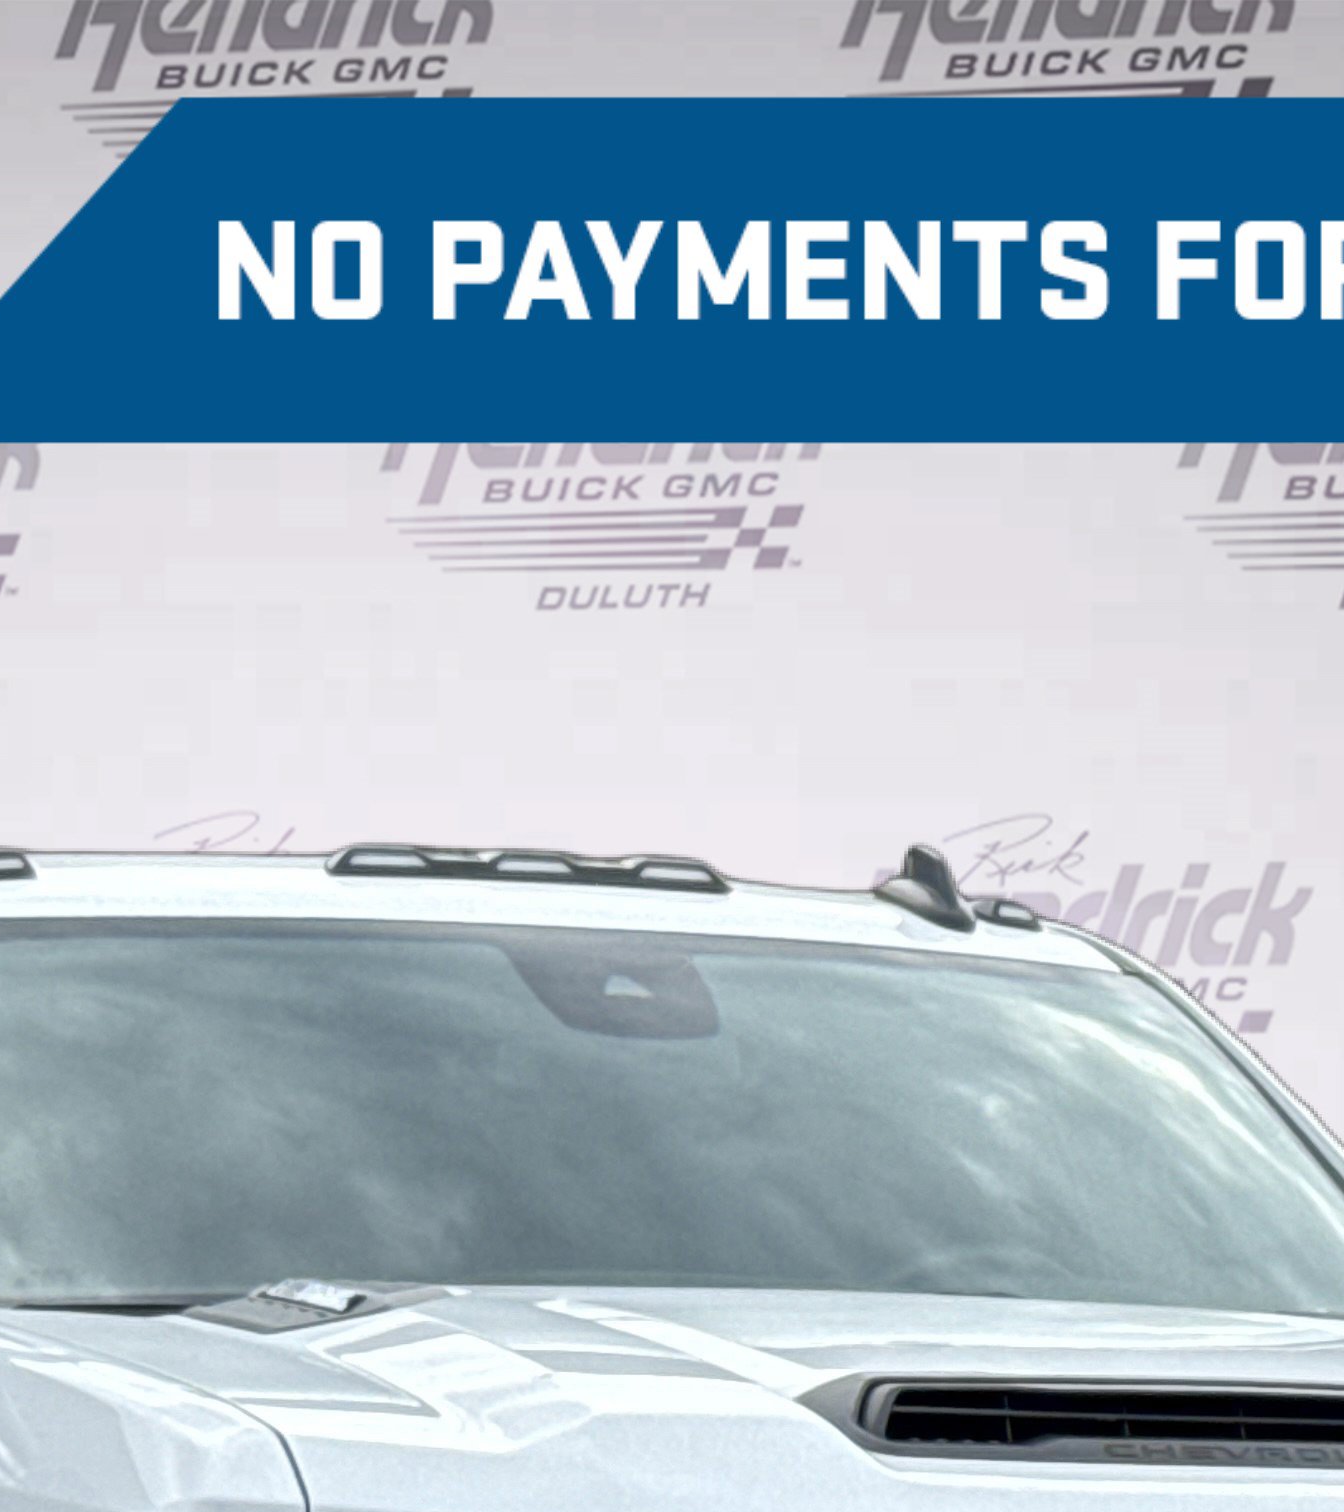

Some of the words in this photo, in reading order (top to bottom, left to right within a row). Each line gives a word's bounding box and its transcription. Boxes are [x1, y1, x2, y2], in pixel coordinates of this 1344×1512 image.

[155, 59, 317, 90] BUICK
[333, 55, 449, 84] GMC
[945, 49, 1111, 80] BUICK
[1128, 44, 1248, 73] GMC
[482, 474, 645, 504] BUICK
[661, 471, 780, 499] GMC
[535, 582, 711, 611] DULUTH
